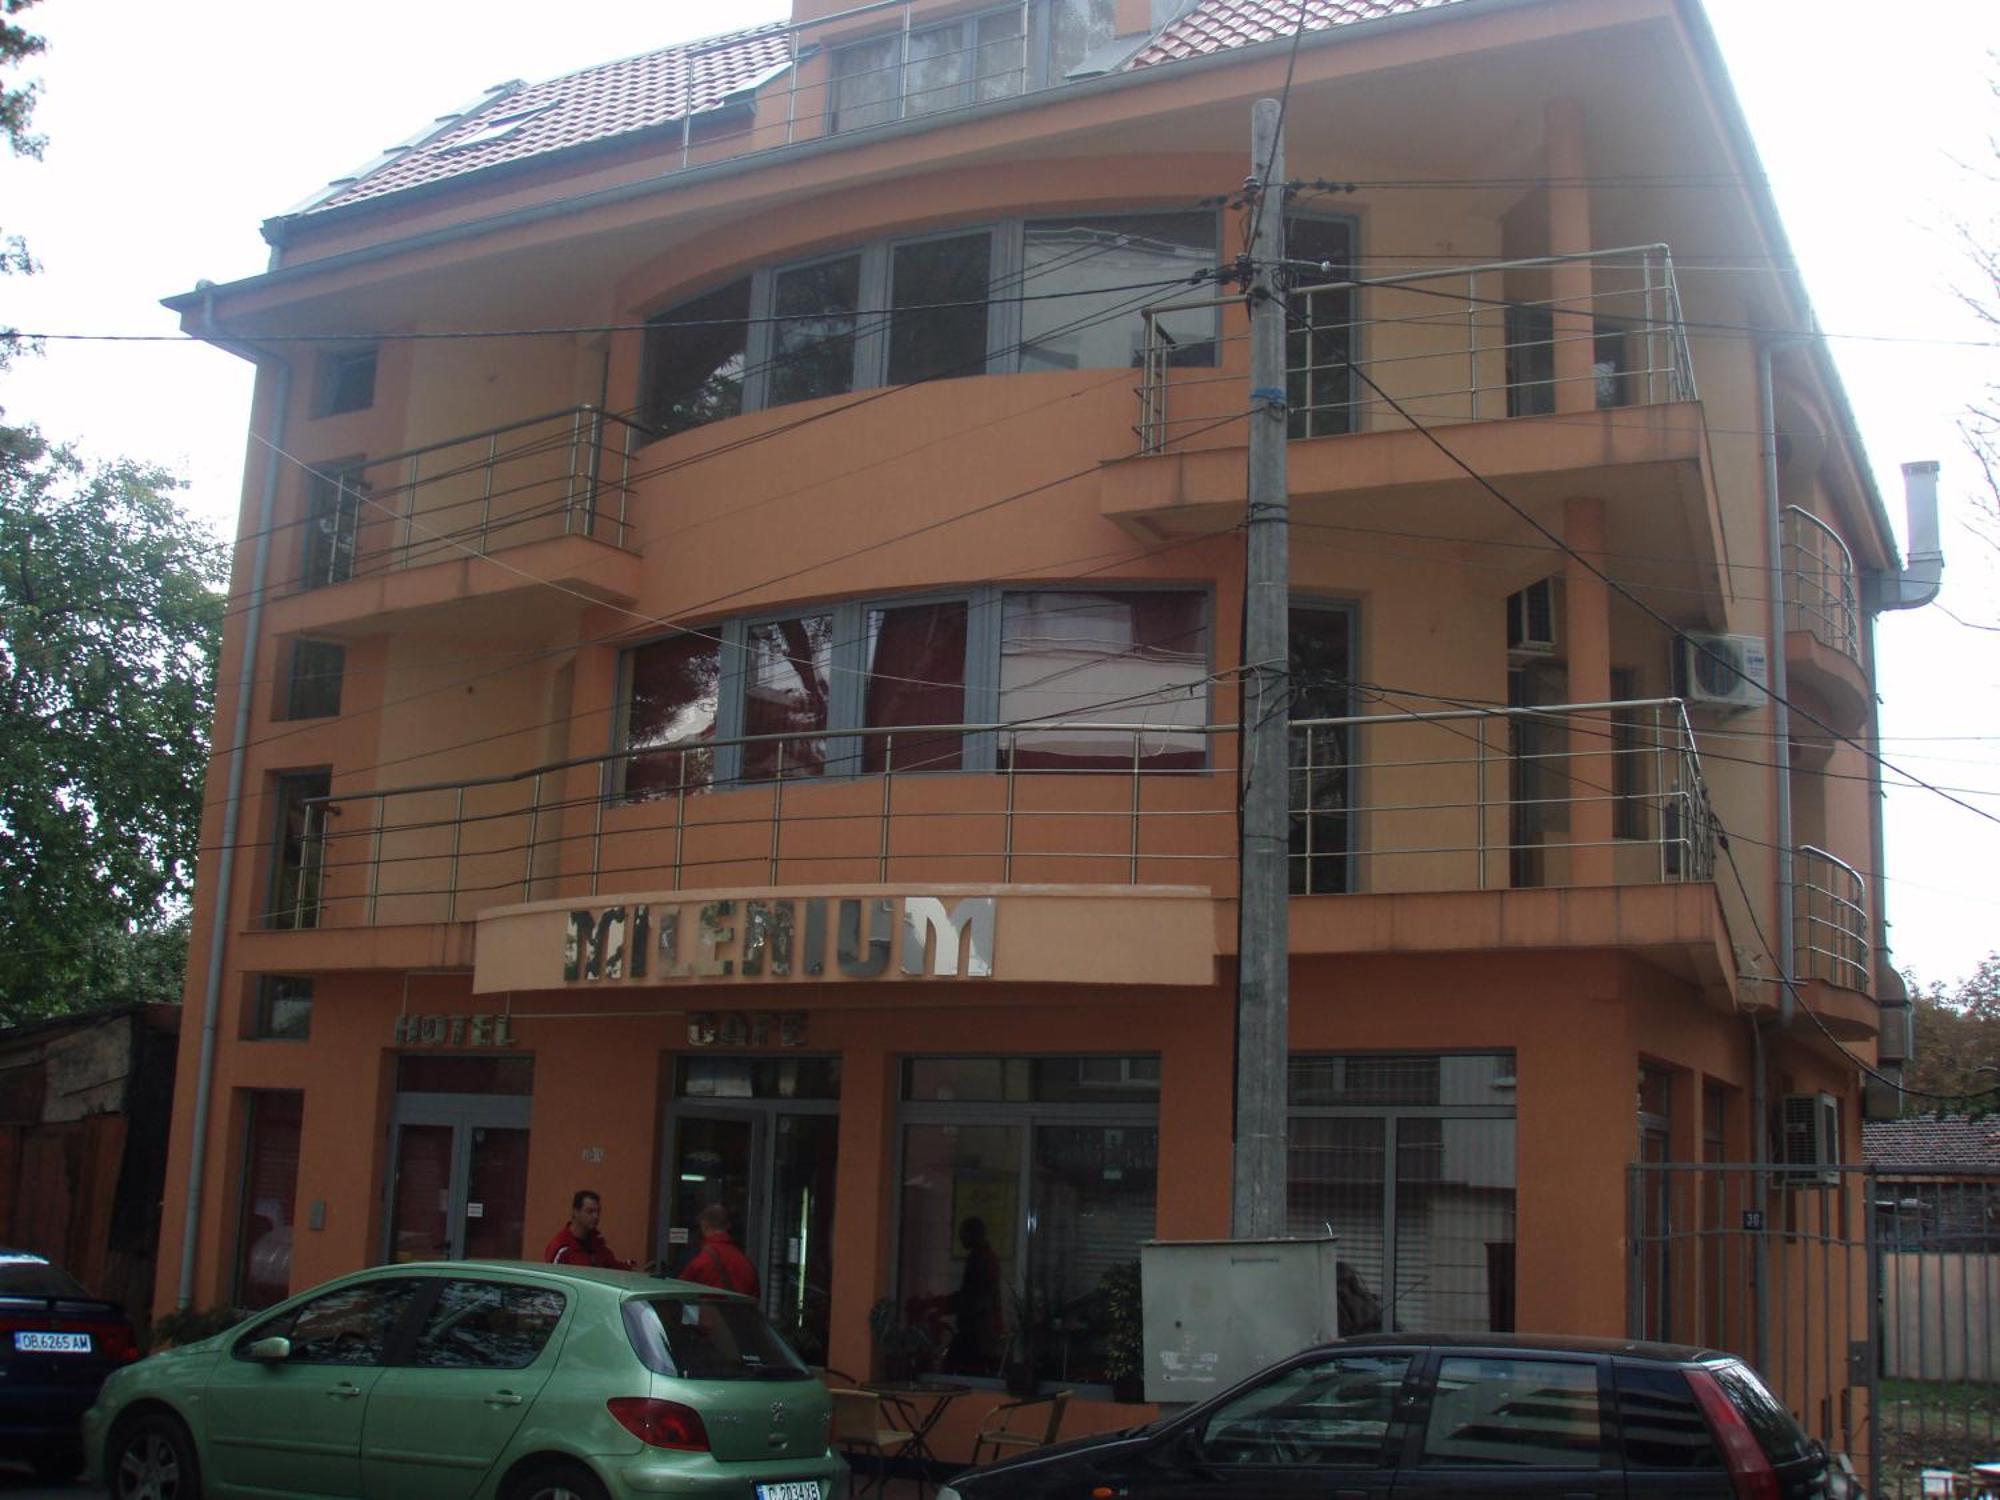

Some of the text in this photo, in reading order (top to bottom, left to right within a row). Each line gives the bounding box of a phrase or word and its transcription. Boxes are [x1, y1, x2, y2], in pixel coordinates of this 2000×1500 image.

[564, 897, 995, 981] MILENIUM
[395, 1013, 517, 1047] HOTEL
[687, 1011, 809, 1047] CAFE
